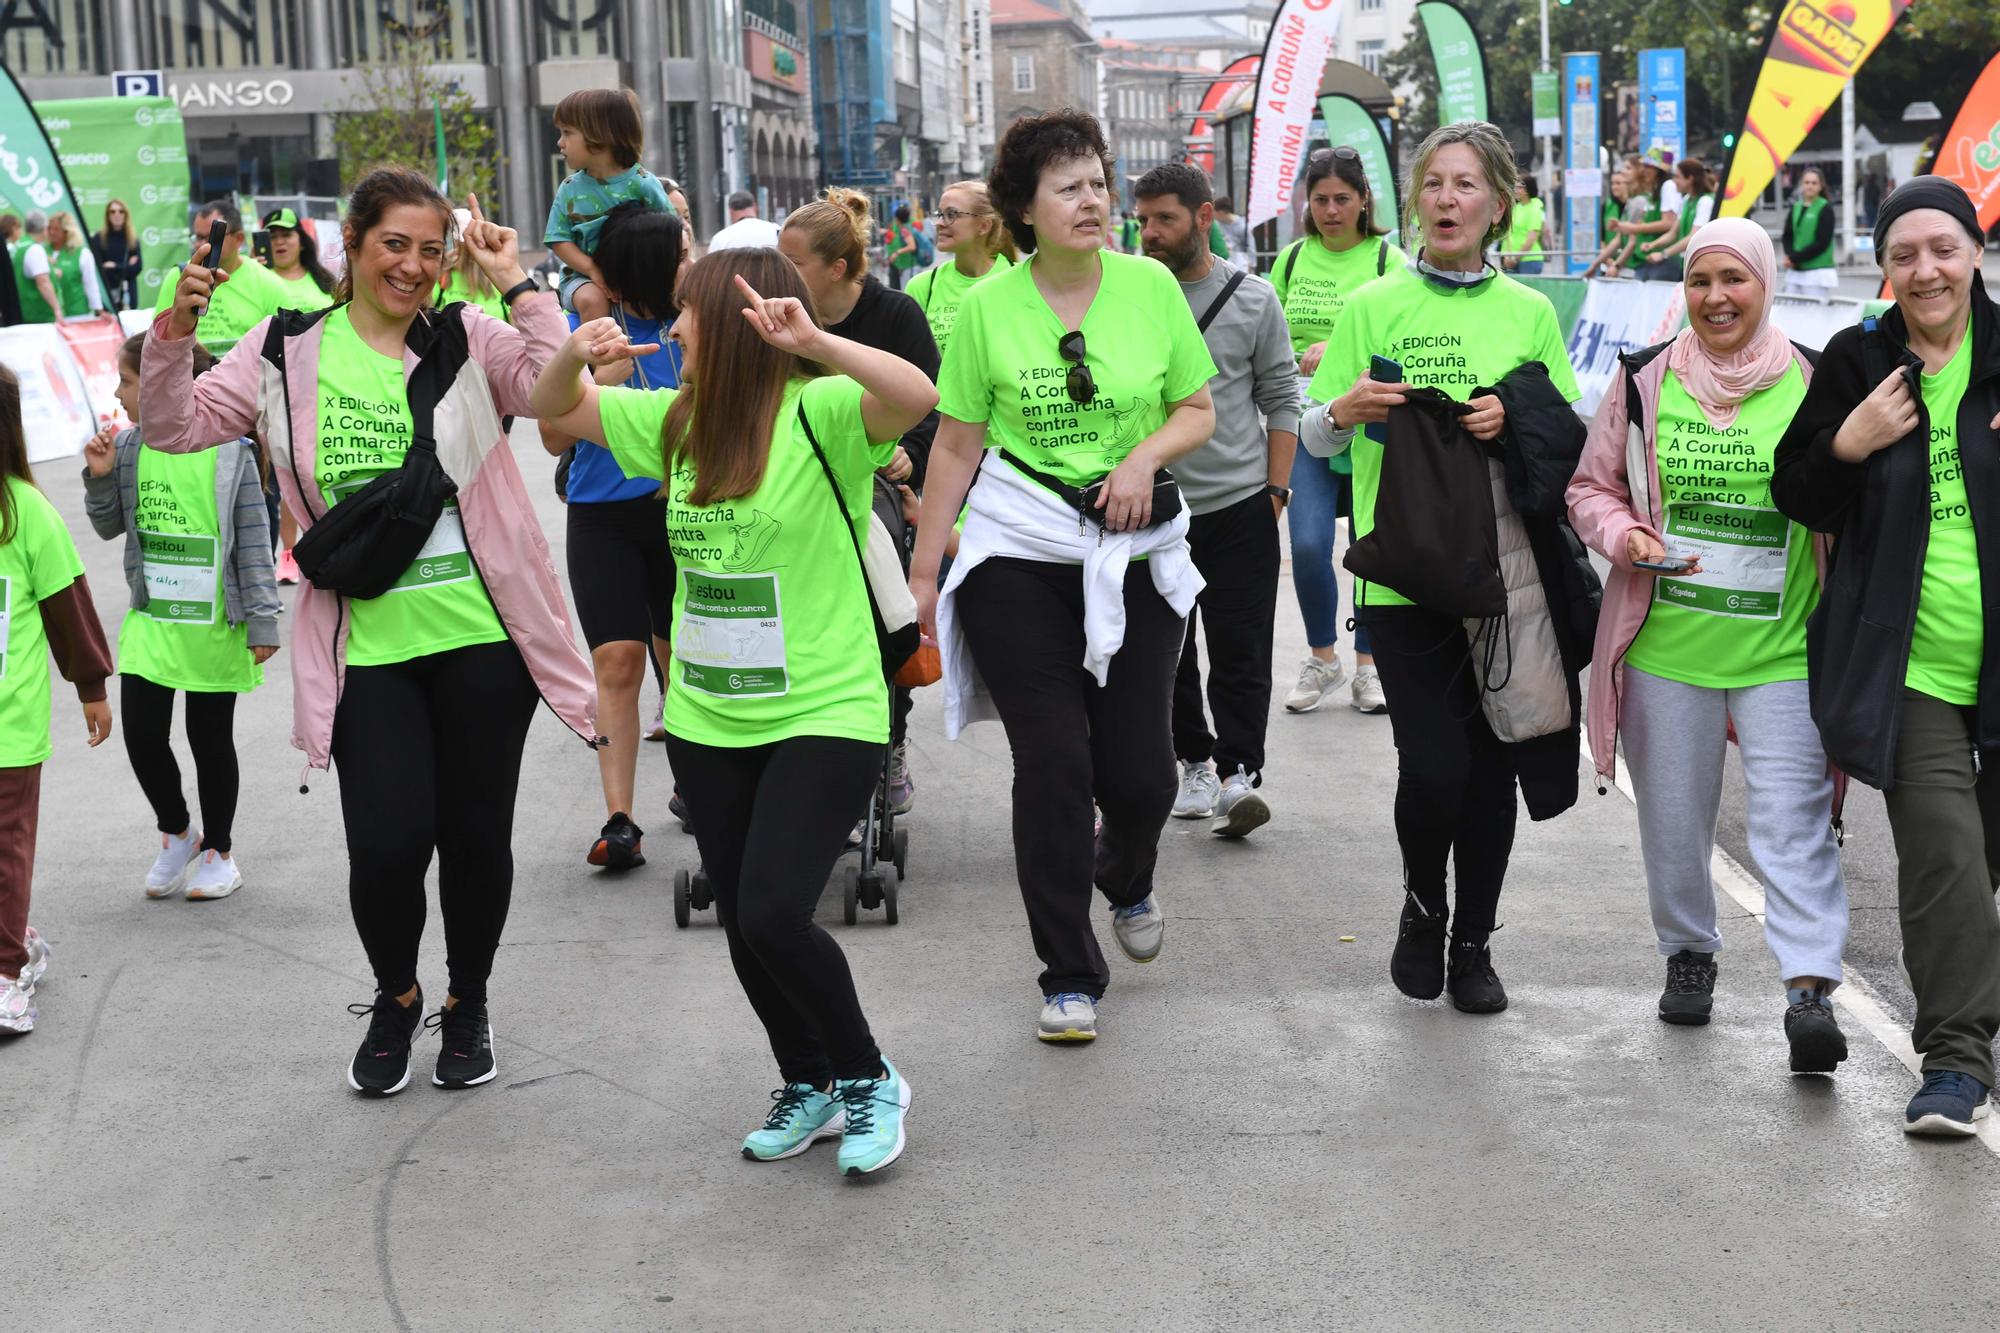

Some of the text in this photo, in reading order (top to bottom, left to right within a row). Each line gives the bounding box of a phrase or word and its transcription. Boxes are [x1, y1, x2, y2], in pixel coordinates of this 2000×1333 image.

[1790, 4, 1863, 61] GADIS
[1268, 13, 1305, 114] A CORUÑA
[125, 77, 150, 97] P
[1298, 287, 1338, 298] Coruña
[1300, 298, 1344, 307] marcha
[1290, 317, 1331, 325] cancro
[1391, 332, 1461, 353] X EDICIÓN
[1404, 352, 1466, 369] Coruña
[1019, 369, 1029, 380] X
[1412, 369, 1478, 385] marcha
[1020, 383, 1100, 400] A Cora
[324, 396, 400, 415] X EDICIÓN
[1021, 397, 1115, 417] en marcha
[322, 415, 407, 434] A Coruña
[1026, 416, 1079, 432] contra
[1674, 421, 1684, 433] X
[322, 435, 411, 451] en march
[1029, 430, 1099, 449] o cancro
[1668, 438, 1756, 456] A Coruña
[323, 451, 384, 466] contra
[1666, 457, 1770, 473] en marcha
[1665, 473, 1727, 487] contra
[1680, 491, 1747, 505] cancro
[676, 507, 734, 523] marcha
[1678, 506, 1753, 529] Eu estou
[667, 526, 706, 541] ontra
[1675, 524, 1686, 532] en
[1686, 526, 1716, 537] marcha
[1716, 530, 1744, 541] contra
[1751, 534, 1778, 543] cancro
[148, 540, 185, 552] estou
[696, 584, 736, 600] estou
[1667, 585, 1697, 599] Vegalsa
[737, 604, 767, 614] cancro
[760, 620, 777, 629] 0433
